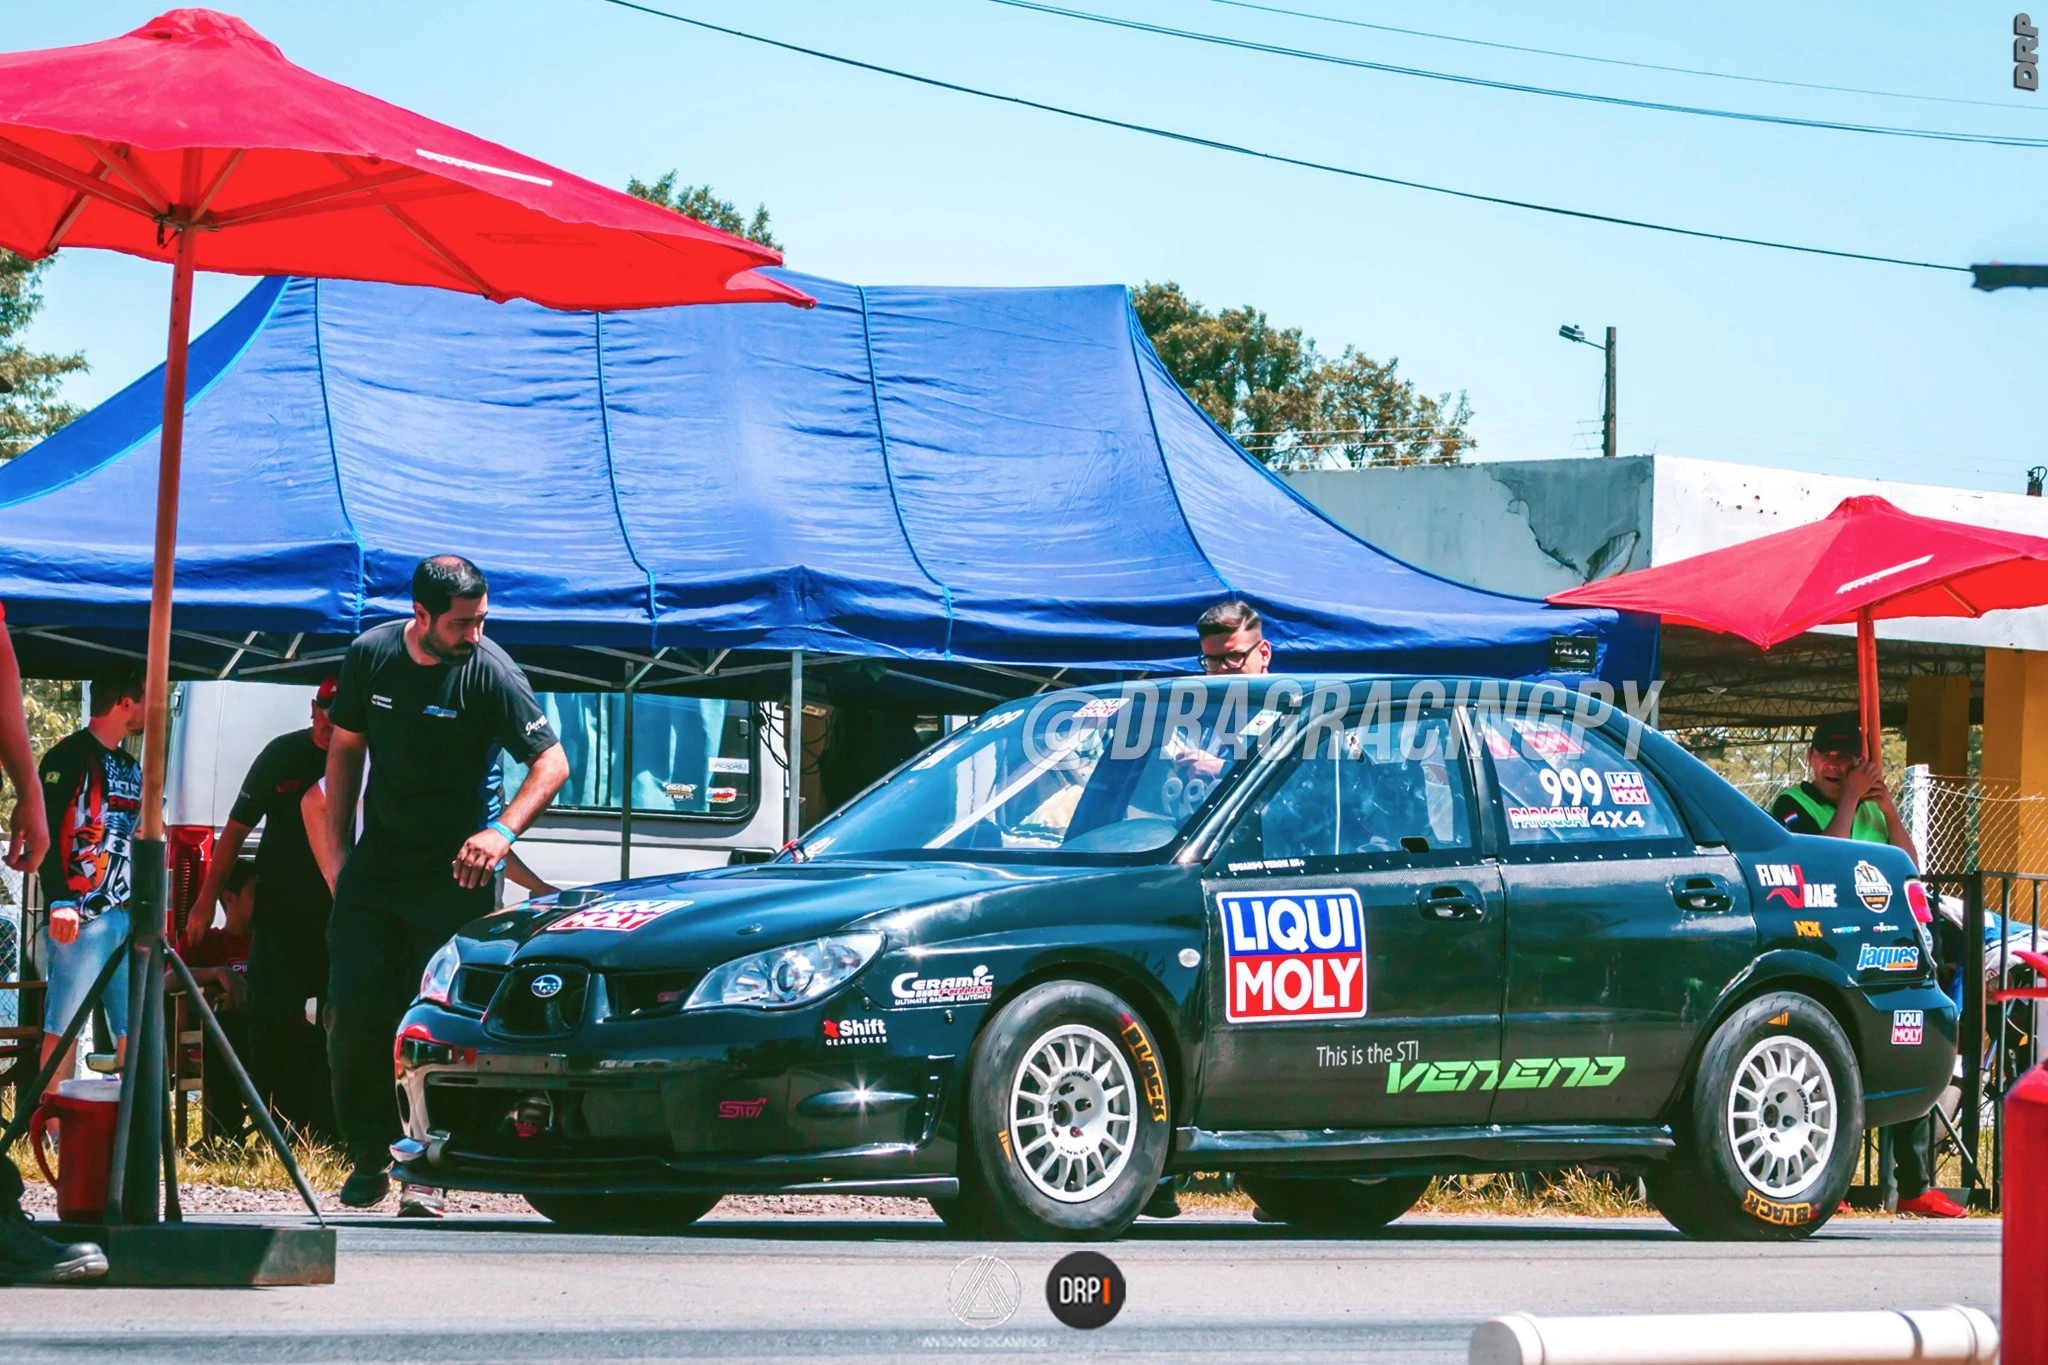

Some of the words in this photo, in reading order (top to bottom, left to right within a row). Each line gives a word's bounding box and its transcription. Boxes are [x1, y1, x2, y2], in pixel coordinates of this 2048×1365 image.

[1539, 767, 1603, 806] 999
[1607, 773, 1642, 788] LIQUI
[1611, 788, 1648, 803] MOLY
[1508, 806, 1590, 829] PARAGUAY
[1590, 810, 1646, 828] 4X4
[1228, 860, 1264, 872] EDUARDO
[1755, 864, 1798, 887] FLOW
[1803, 883, 1838, 908] RACE
[556, 913, 659, 929] MOLY
[1228, 898, 1356, 953] LIQUI
[891, 966, 994, 999] CERAMIC
[1236, 957, 1361, 1012] MOLY
[895, 997, 928, 1005] ULTIMATE
[956, 993, 992, 1002] CLUTCHES
[1895, 1012, 1922, 1027] LIQUI
[826, 1036, 887, 1046] GEARBOXES
[1893, 1028, 1922, 1043] MOLY
[1316, 1046, 1348, 1067] This
[1351, 1045, 1363, 1065] is
[1367, 1042, 1393, 1065] the
[1396, 1040, 1419, 1062] STI
[1121, 1021, 1168, 1122] BLACK
[1386, 1056, 1626, 1094] VENENO
[1741, 1189, 1811, 1226] BLACK
